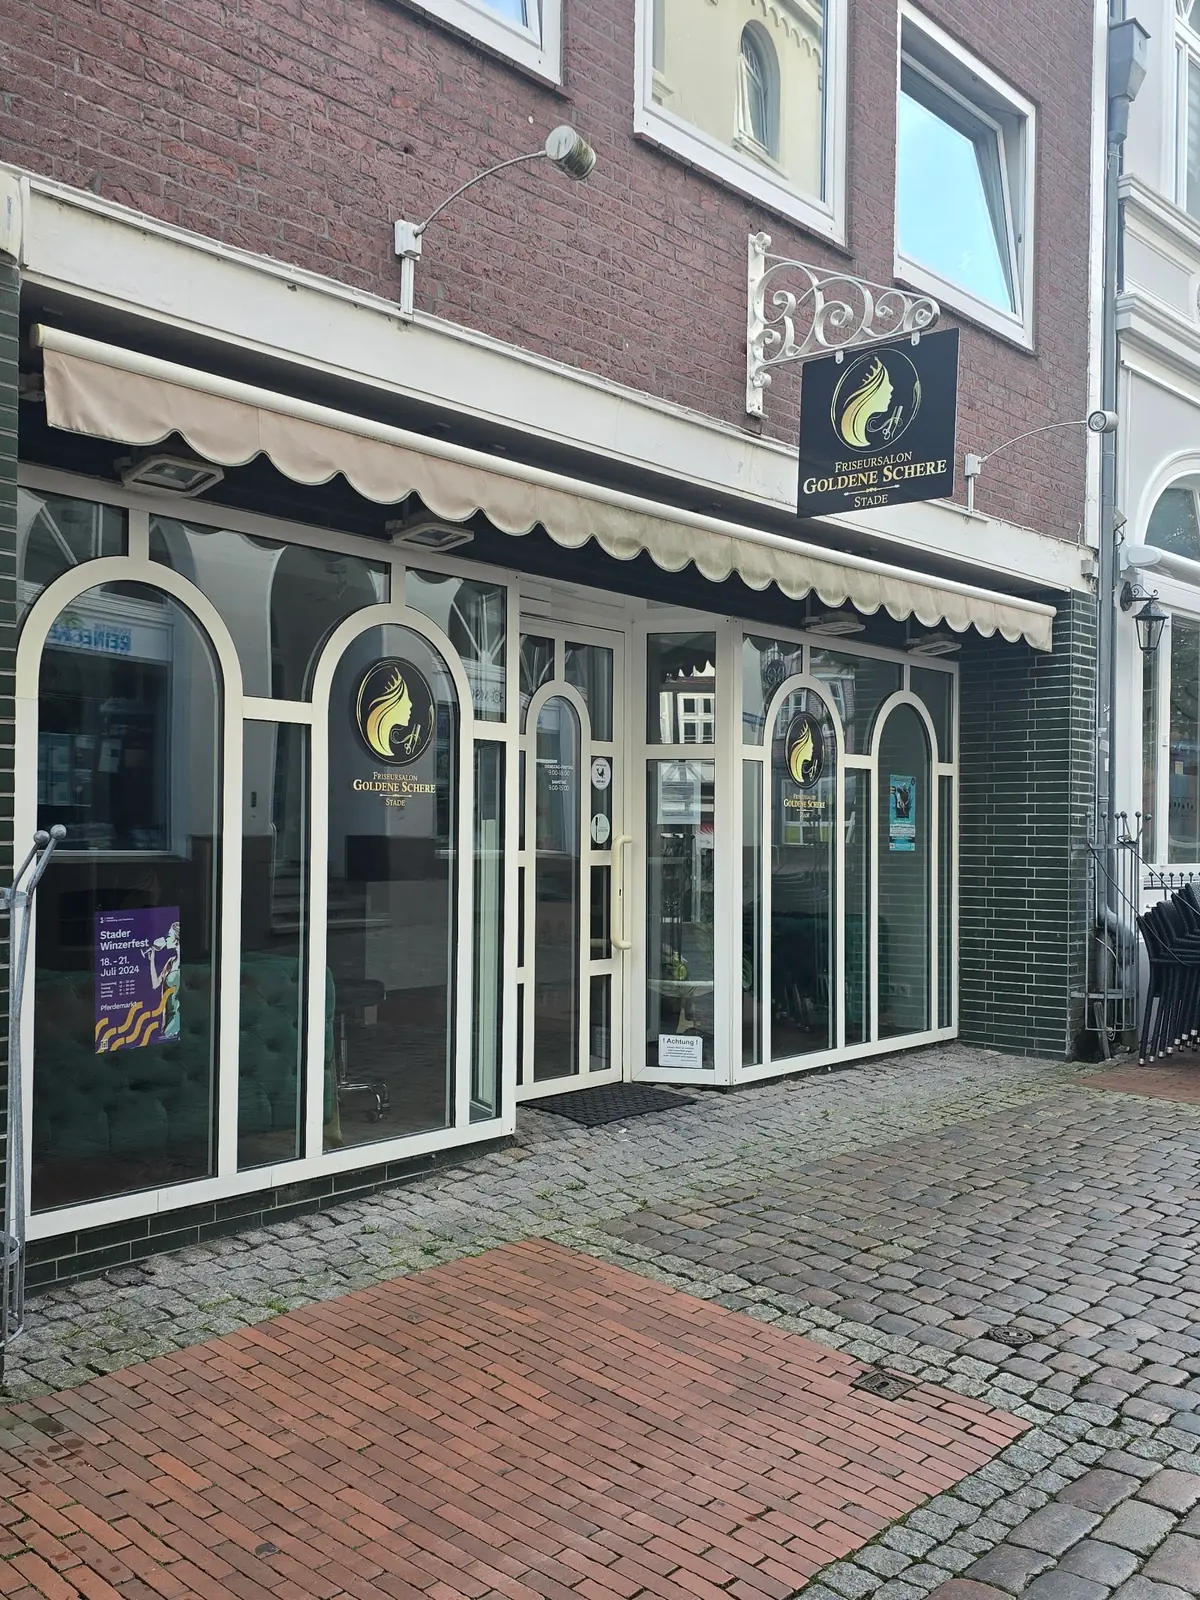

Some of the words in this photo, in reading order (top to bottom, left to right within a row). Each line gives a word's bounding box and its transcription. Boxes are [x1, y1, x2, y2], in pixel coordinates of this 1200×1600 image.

[835, 452, 912, 473] FRISEURSALON
[803, 471, 879, 495] GOLDENE
[883, 460, 947, 482] SCHERE
[854, 494, 889, 508] STADE
[373, 771, 418, 782] FRISEURSALON
[353, 779, 400, 792] GOLDENE
[401, 781, 437, 794] SCHERE
[385, 798, 406, 807] STADE
[100, 930, 131, 939] Stader
[100, 939, 149, 951] Winzerfest
[100, 966, 117, 977] Juli
[119, 965, 139, 974] 2024
[667, 1038, 694, 1046] Achtung
